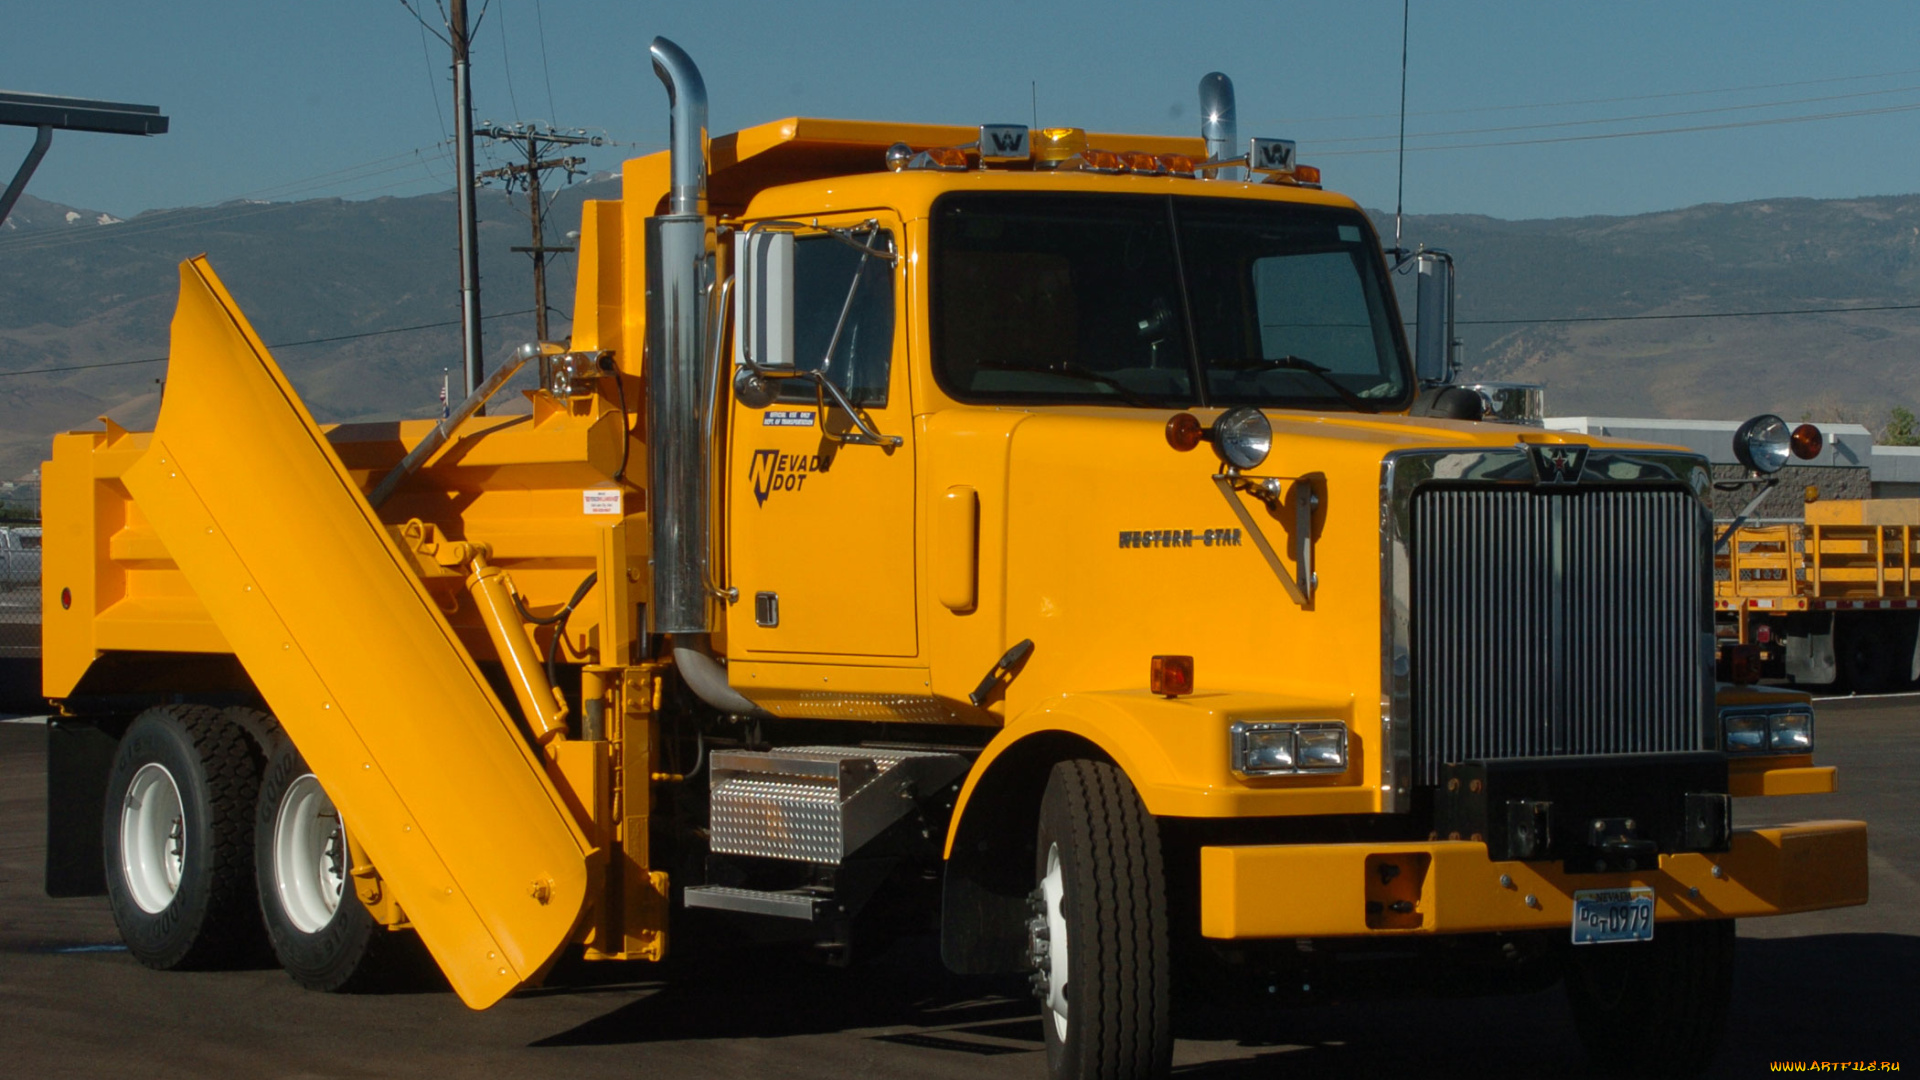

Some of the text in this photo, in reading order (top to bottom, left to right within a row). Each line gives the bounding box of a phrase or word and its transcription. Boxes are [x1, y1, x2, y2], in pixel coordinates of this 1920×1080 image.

[772, 474, 807, 491] DOT
[1119, 528, 1241, 549] WESTERN STAR
